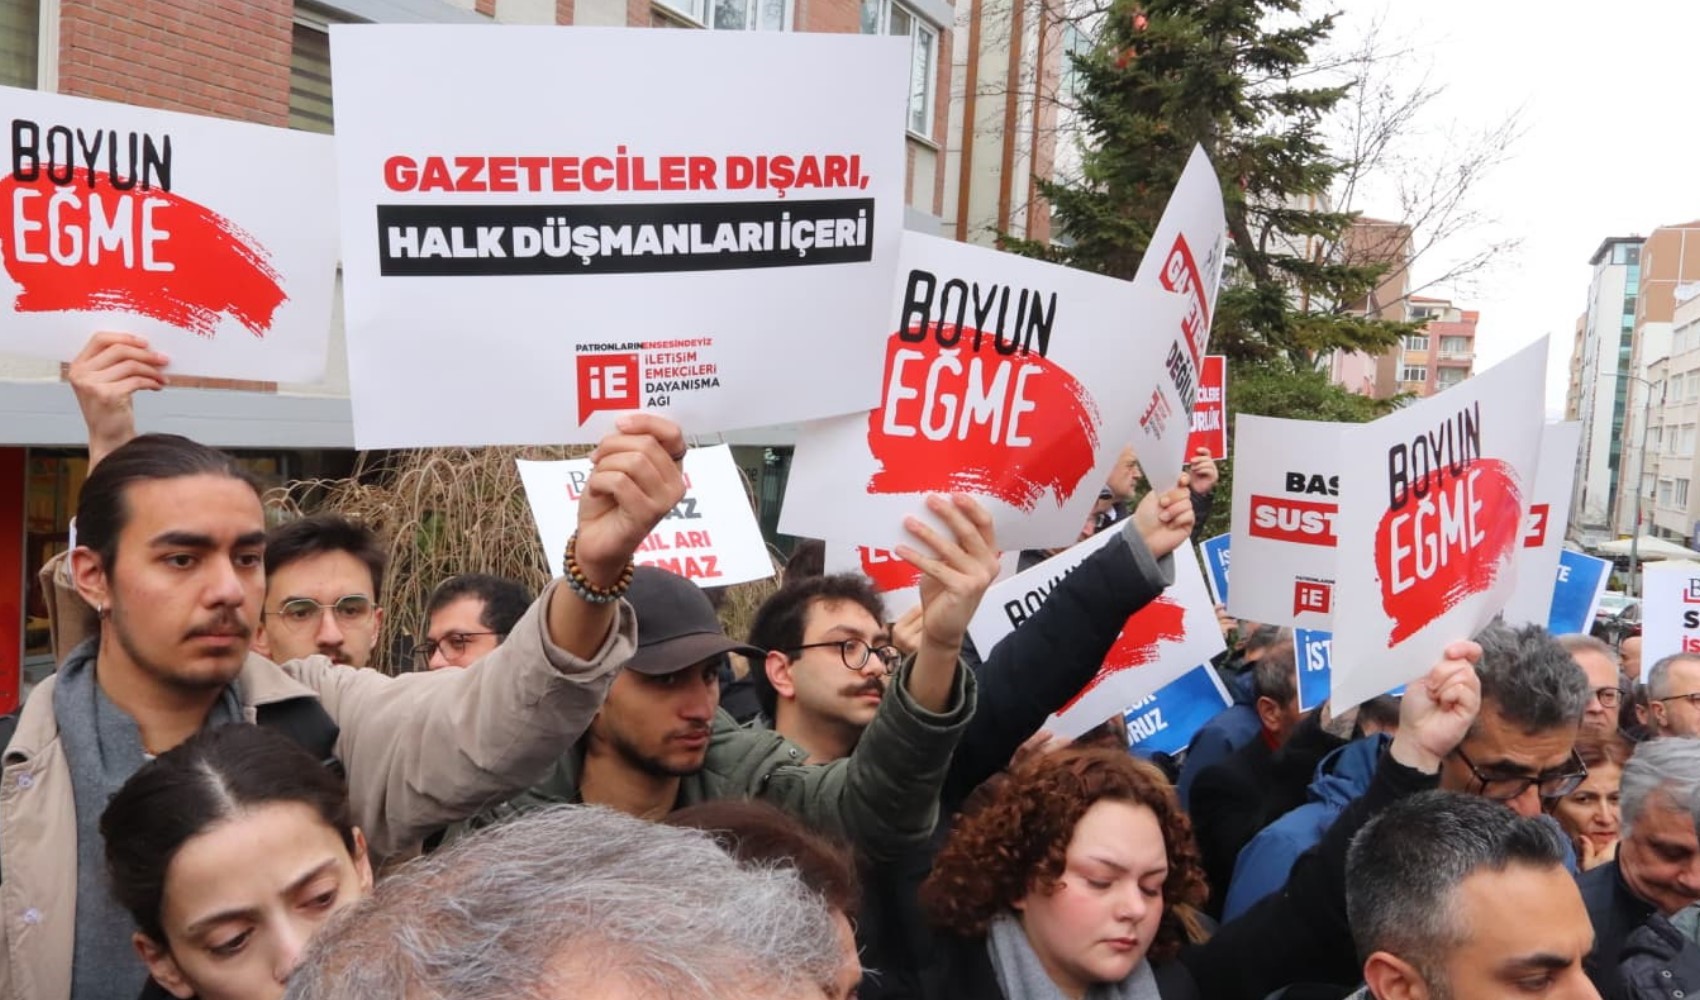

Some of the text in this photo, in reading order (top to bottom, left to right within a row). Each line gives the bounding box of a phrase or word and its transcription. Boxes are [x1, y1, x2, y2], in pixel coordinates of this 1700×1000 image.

[12, 119, 172, 192] BOYUN
[384, 145, 870, 199] GAZETECİLER DIŞARI,
[13, 186, 176, 272] EĞME
[387, 209, 867, 266] HALK DÜŞMANLARI İÇERİ
[899, 269, 1058, 358] BOYUN
[883, 347, 1044, 448] EĞME
[1389, 400, 1481, 511] BOYUN
[675, 530, 712, 548] ARI
[1390, 469, 1486, 595] EĞME
